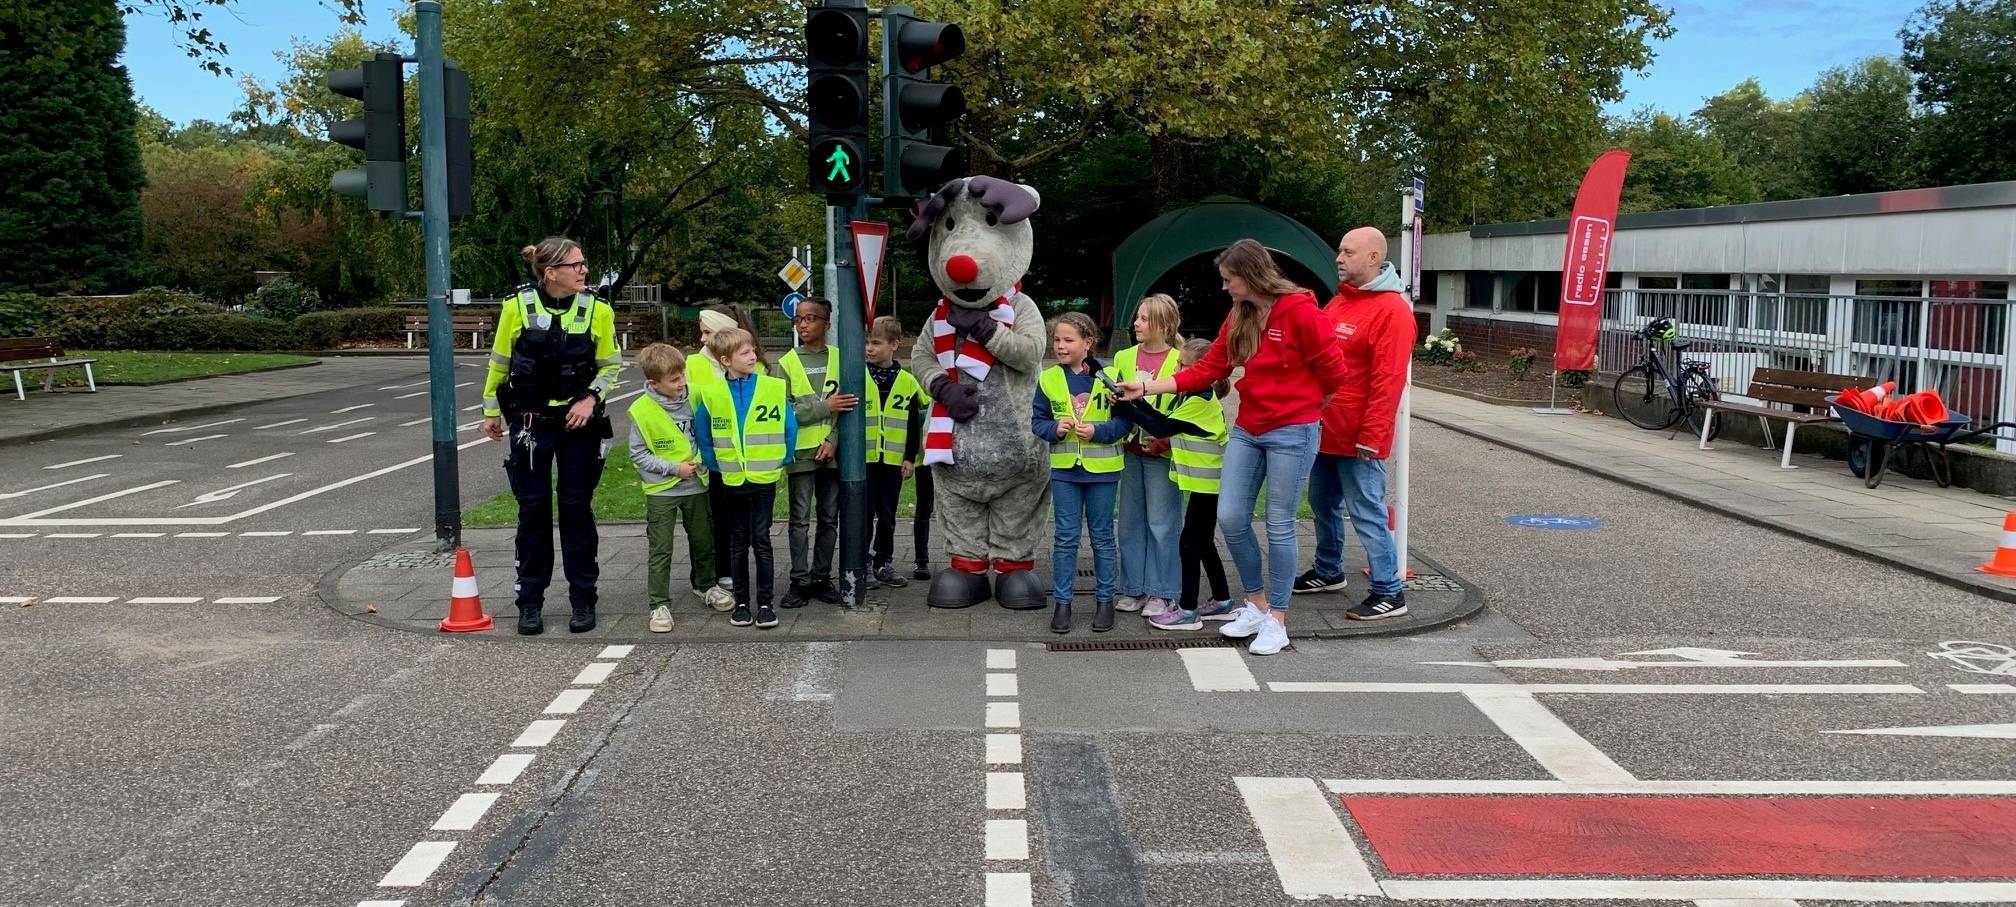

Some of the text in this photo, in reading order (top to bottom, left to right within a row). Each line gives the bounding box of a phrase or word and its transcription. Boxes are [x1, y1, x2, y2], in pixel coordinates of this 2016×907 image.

[1575, 224, 1593, 298] radio essen
[1092, 392, 1109, 410] 1
[755, 404, 782, 423] 24
